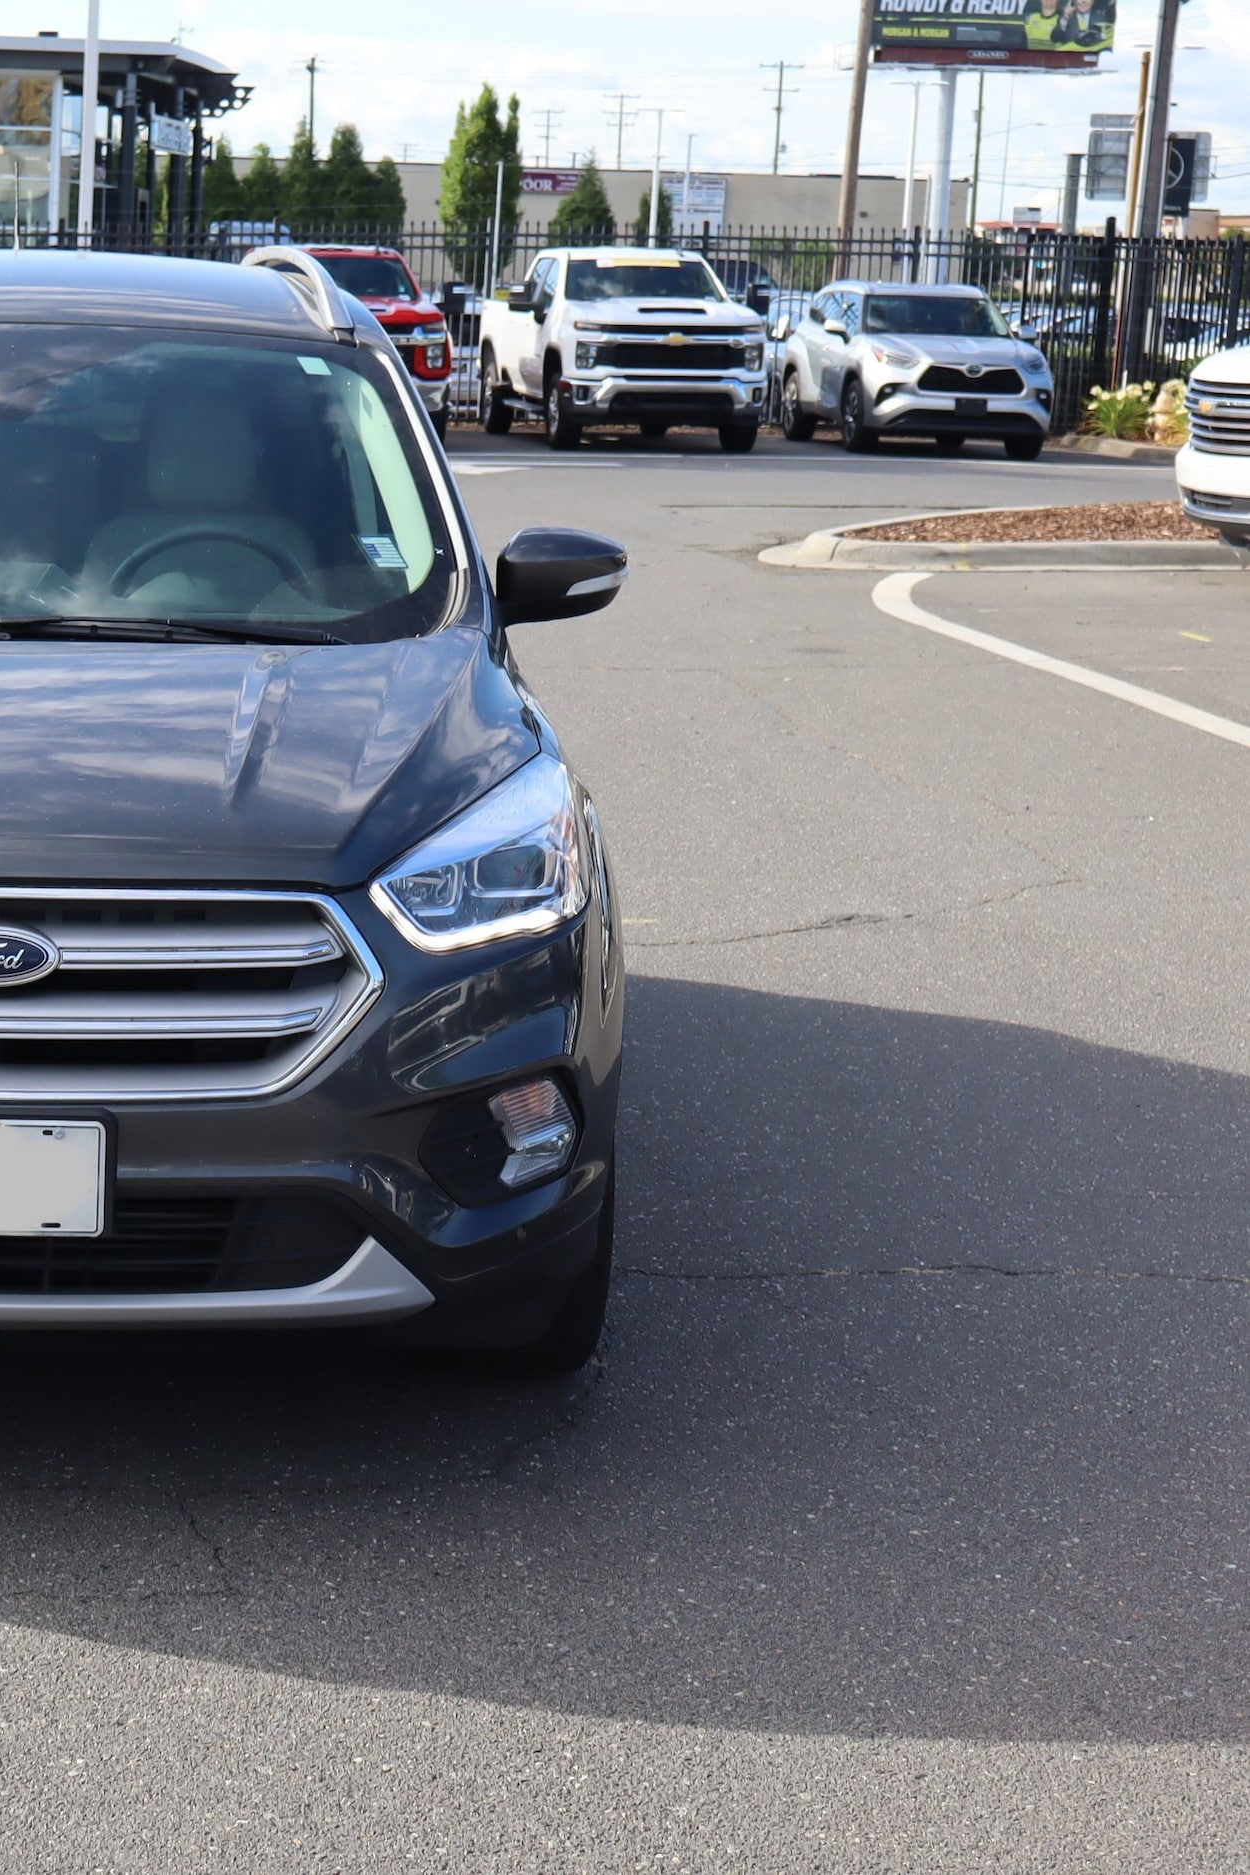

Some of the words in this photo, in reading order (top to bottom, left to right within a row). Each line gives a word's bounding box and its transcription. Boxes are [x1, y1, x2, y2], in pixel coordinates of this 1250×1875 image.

[879, 0, 948, 13] ROWDY
[950, 0, 964, 14] &
[966, 0, 1027, 15] READY
[518, 176, 553, 191] OOR
